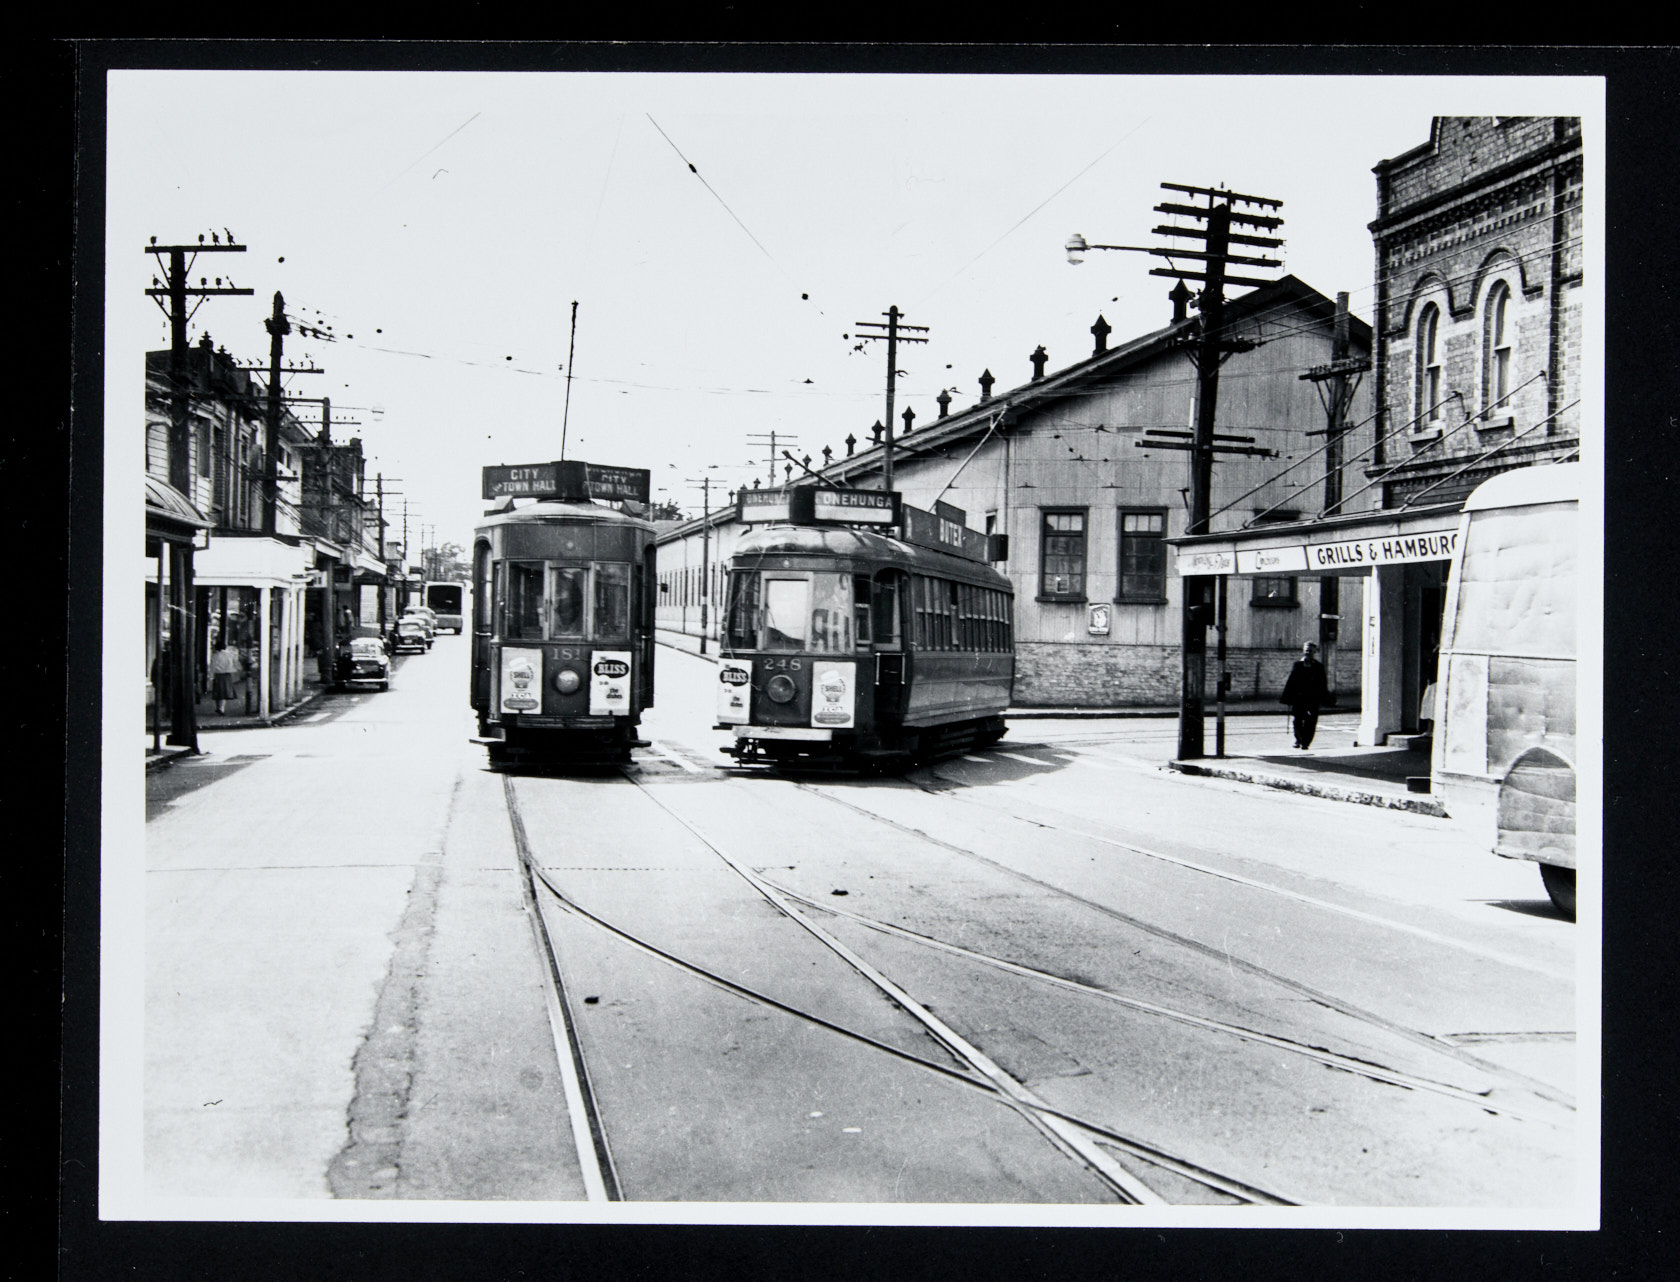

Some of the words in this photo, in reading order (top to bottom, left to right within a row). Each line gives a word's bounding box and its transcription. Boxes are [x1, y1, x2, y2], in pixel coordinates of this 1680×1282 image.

[511, 468, 539, 480] CITY
[601, 474, 627, 484] CITY
[502, 481, 529, 492] TOWN
[532, 479, 556, 491] HALL
[616, 484, 639, 496] HALL
[823, 493, 893, 508] ONEHUNGA
[1317, 544, 1363, 565] GRILLS
[1369, 543, 1378, 561] &
[597, 663, 627, 675] BLISS
[764, 658, 802, 671] 248
[513, 671, 530, 679] SHELL
[722, 671, 747, 684] BLISS
[825, 685, 842, 693] SHELL
